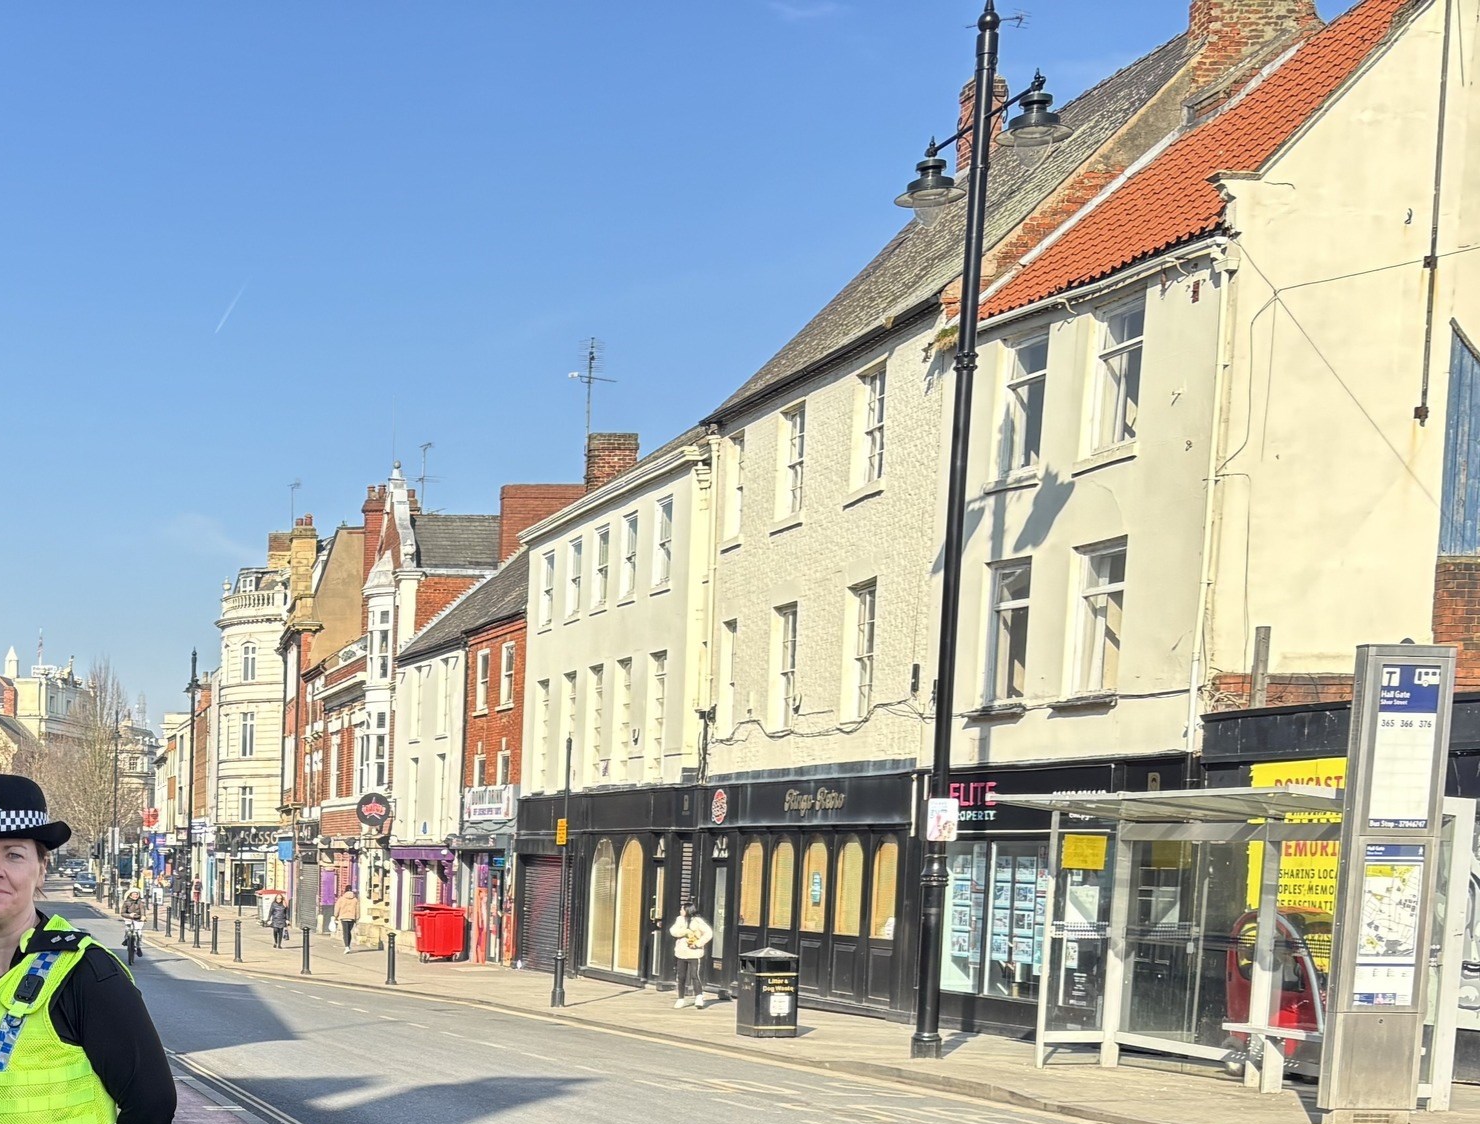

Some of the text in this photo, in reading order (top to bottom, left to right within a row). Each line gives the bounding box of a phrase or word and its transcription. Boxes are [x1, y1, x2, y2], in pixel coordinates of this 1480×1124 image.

[1380, 690, 1411, 699] Hall Gate
[1381, 719, 1432, 728] 365 366 376
[950, 781, 998, 807] ELITE
[958, 810, 997, 821] OPERTY
[1283, 840, 1338, 857] EMORI
